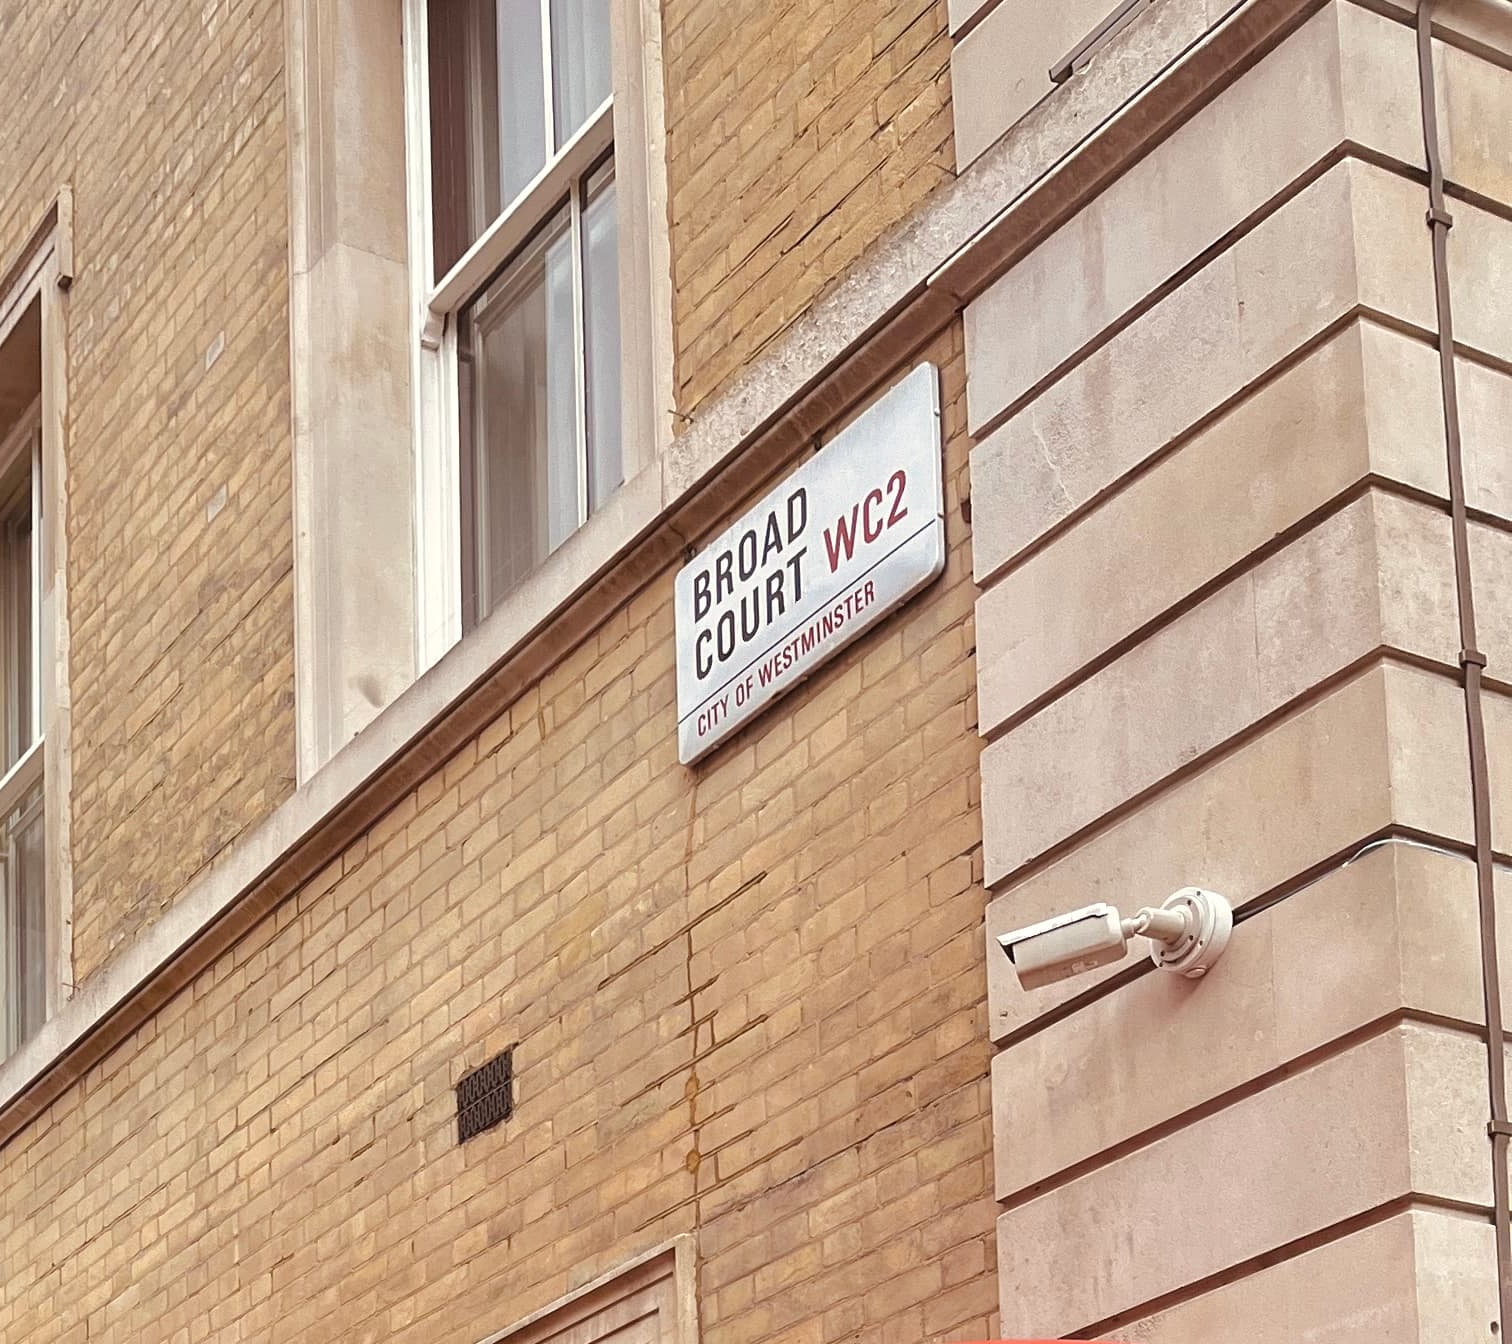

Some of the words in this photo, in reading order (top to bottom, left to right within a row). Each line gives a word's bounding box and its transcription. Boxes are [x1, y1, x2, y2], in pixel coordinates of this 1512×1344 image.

[694, 487, 807, 624] BROAD
[695, 546, 808, 680] COURT
[823, 469, 908, 574] WC2
[697, 693, 729, 737] CITY
[735, 674, 754, 709] OF
[758, 579, 876, 688] WESTMINSTER
